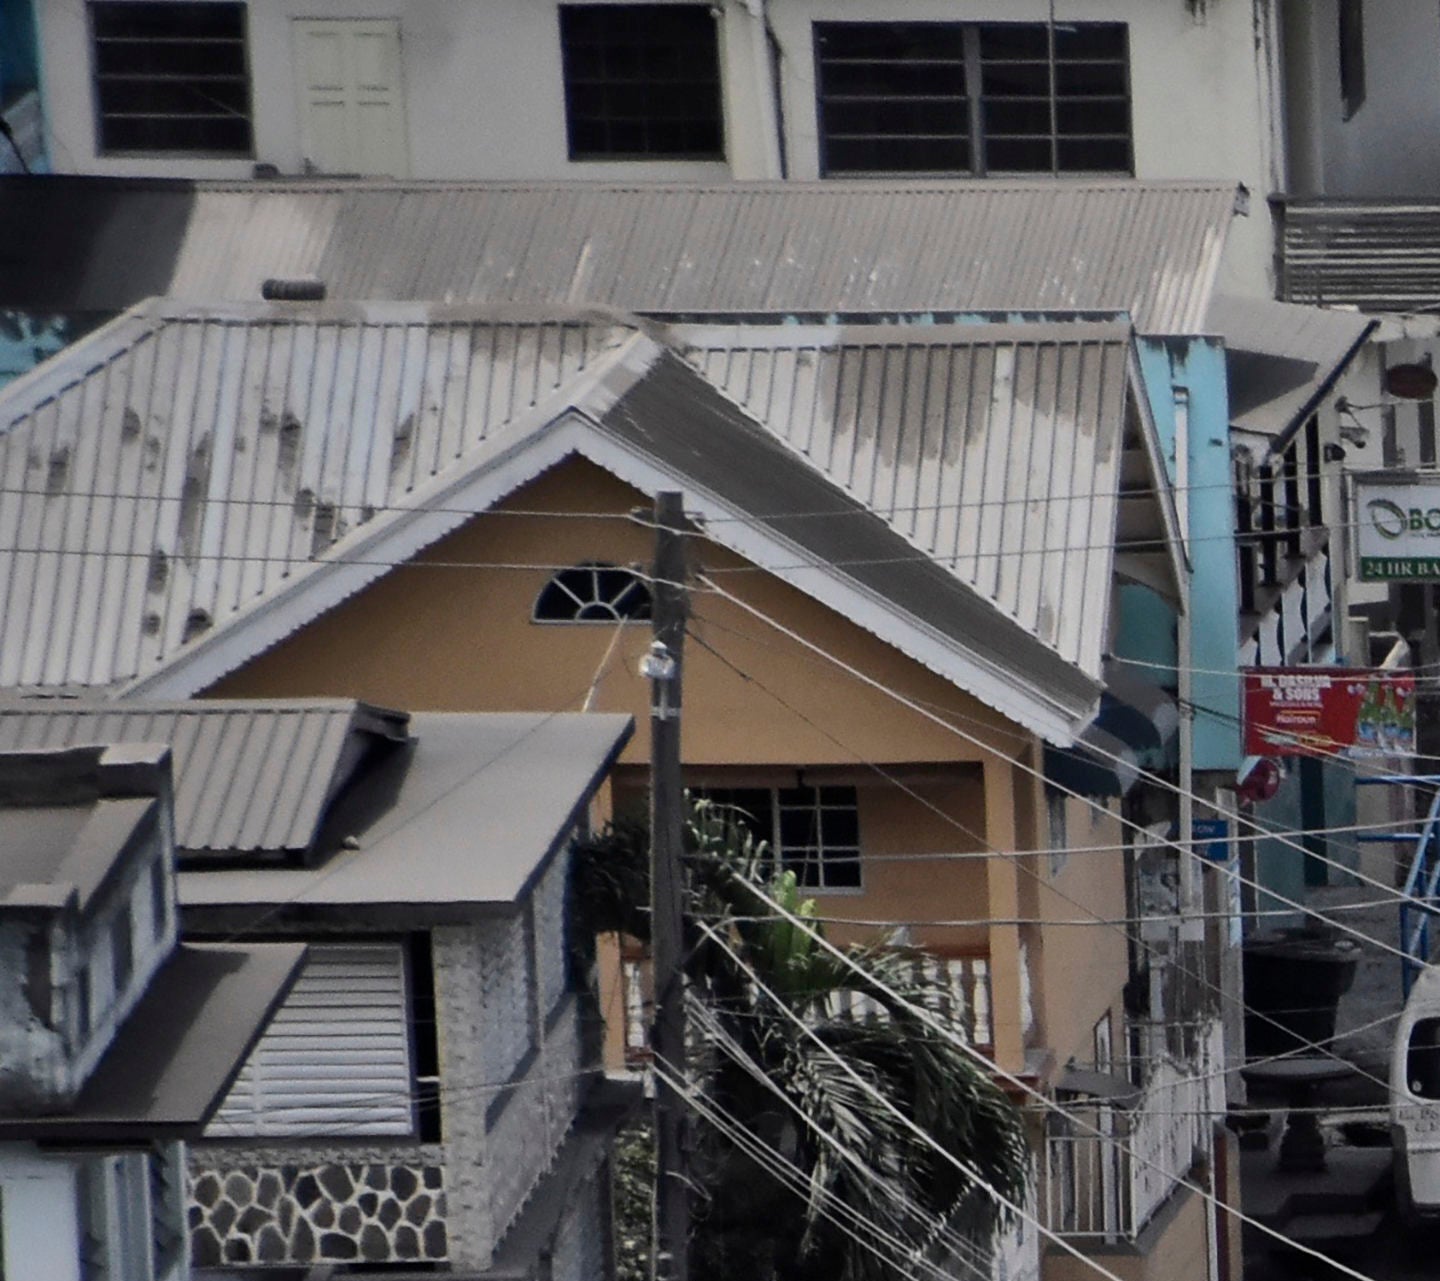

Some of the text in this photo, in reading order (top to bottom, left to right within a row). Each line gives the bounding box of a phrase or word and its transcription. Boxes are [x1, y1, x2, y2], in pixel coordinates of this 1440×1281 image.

[1366, 561, 1383, 576] 24
[1387, 561, 1413, 576] HR
[1285, 688, 1320, 701] SONS
